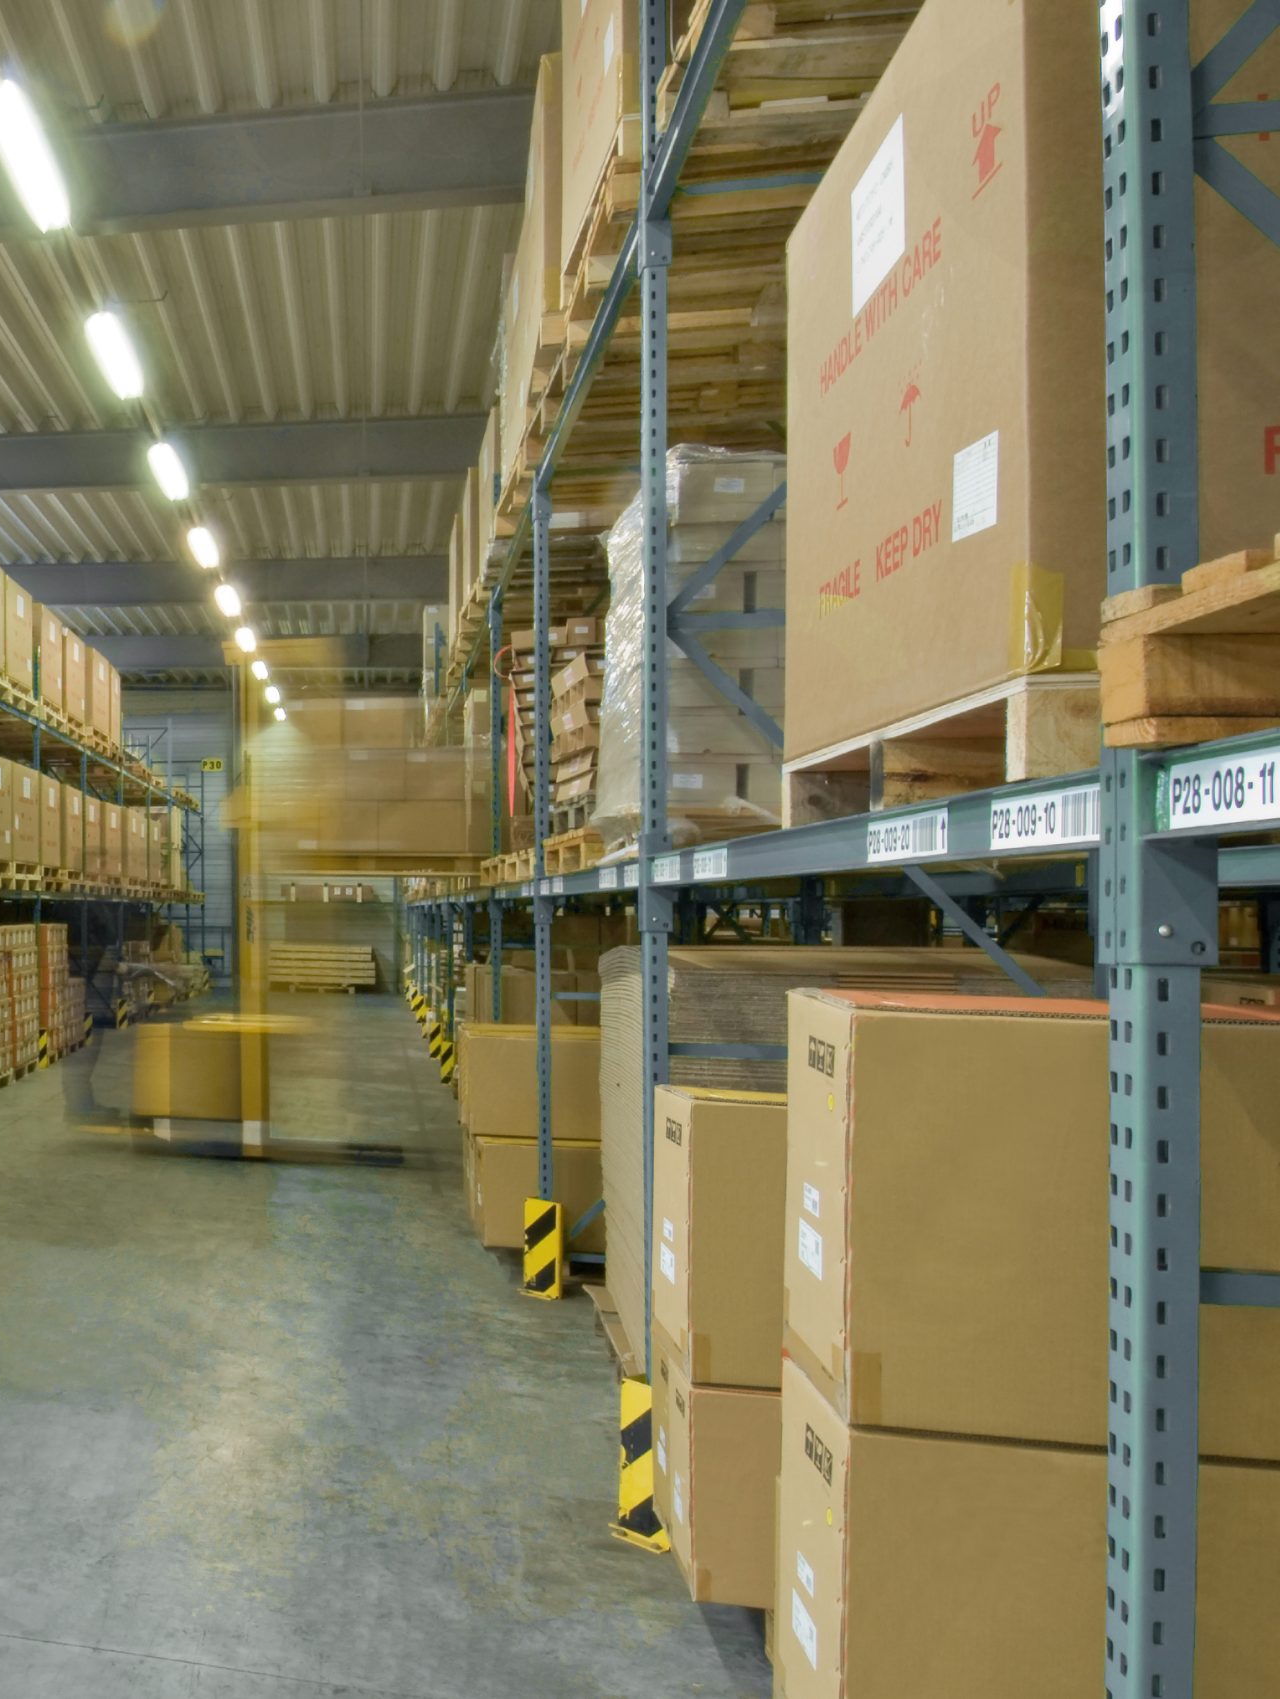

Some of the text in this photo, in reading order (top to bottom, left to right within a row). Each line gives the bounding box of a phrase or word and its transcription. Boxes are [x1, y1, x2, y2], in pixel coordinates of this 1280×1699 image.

[972, 82, 1001, 138] UP
[820, 317, 862, 398] HANDLE
[864, 271, 898, 342] WITH
[902, 215, 942, 298] CARE
[818, 498, 943, 620] FRAGILE KEEP DRY
[202, 760, 222, 770] P30
[1172, 761, 1275, 815] P28-008-11
[868, 801, 1057, 855] P28-009-20 P28-009-10
